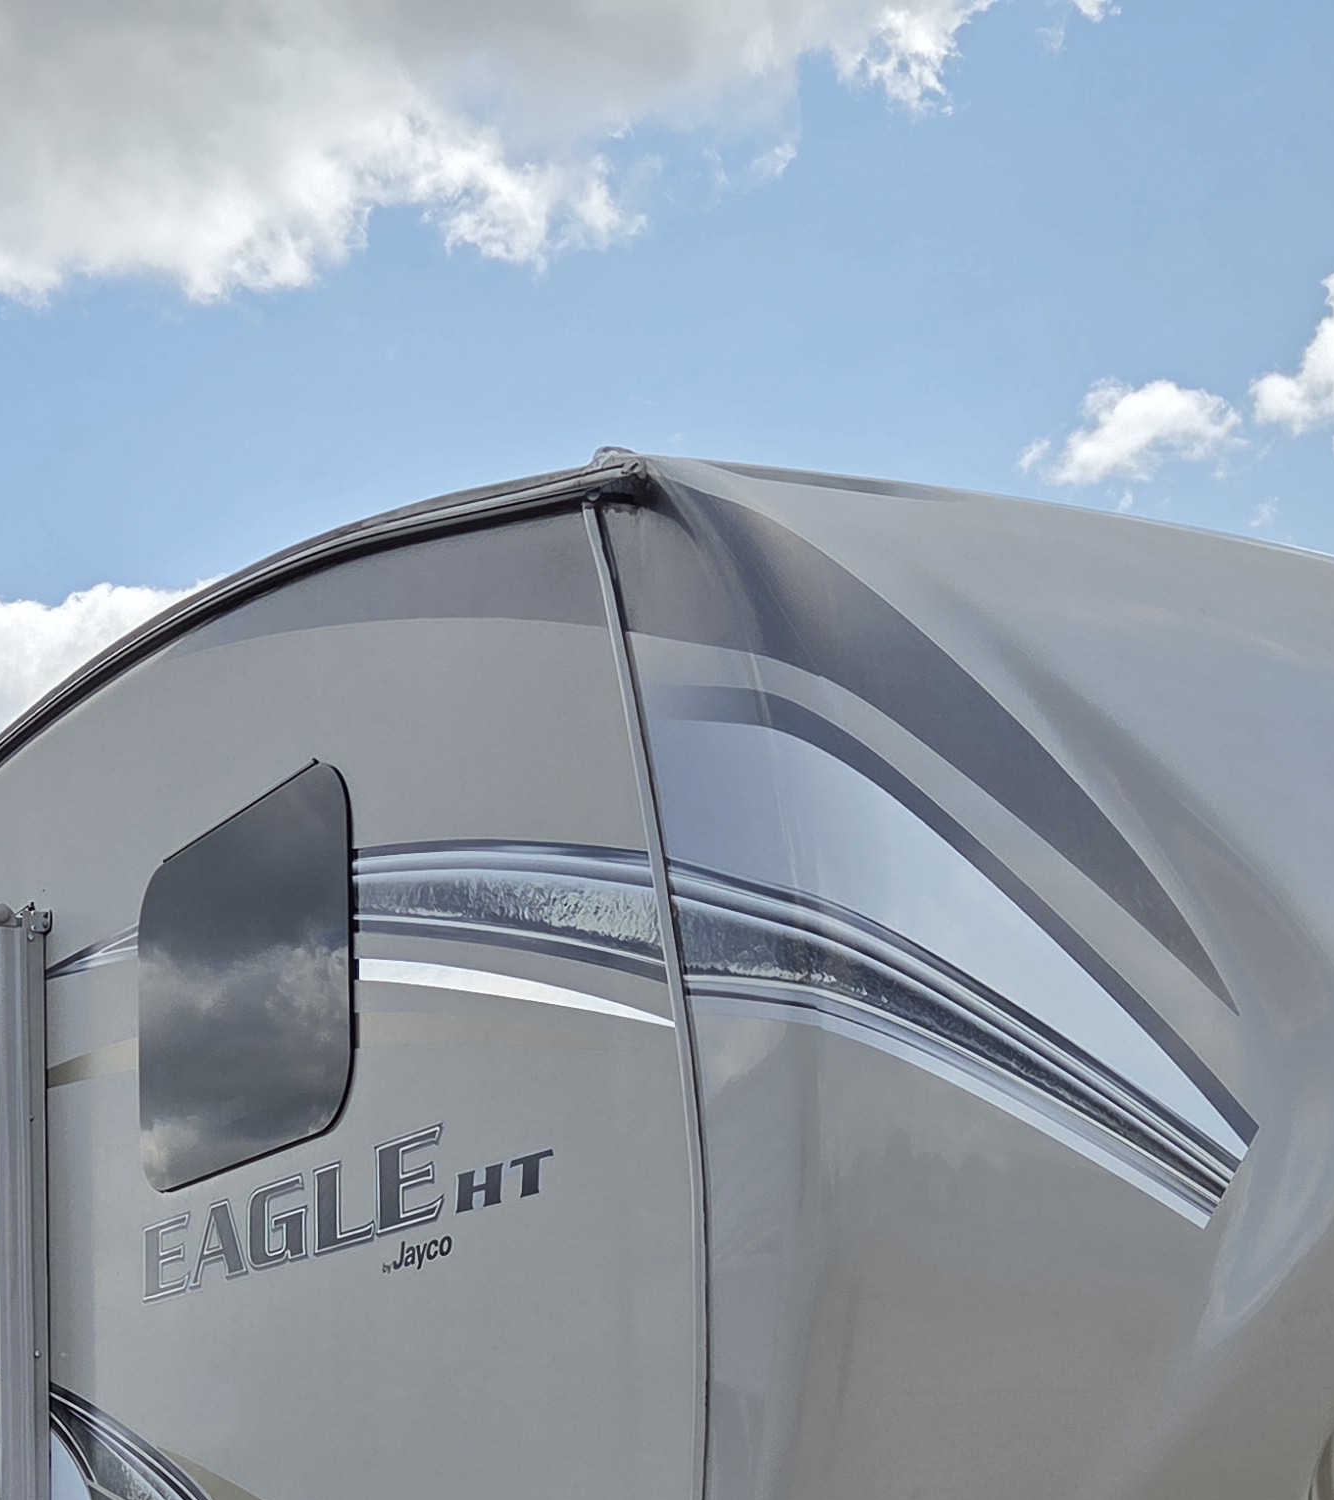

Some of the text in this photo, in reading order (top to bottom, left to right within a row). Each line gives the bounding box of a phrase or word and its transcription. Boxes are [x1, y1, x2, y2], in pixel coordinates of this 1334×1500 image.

[141, 1122, 554, 1303] EAGLE HT
[392, 1235, 453, 1270] Jayco
